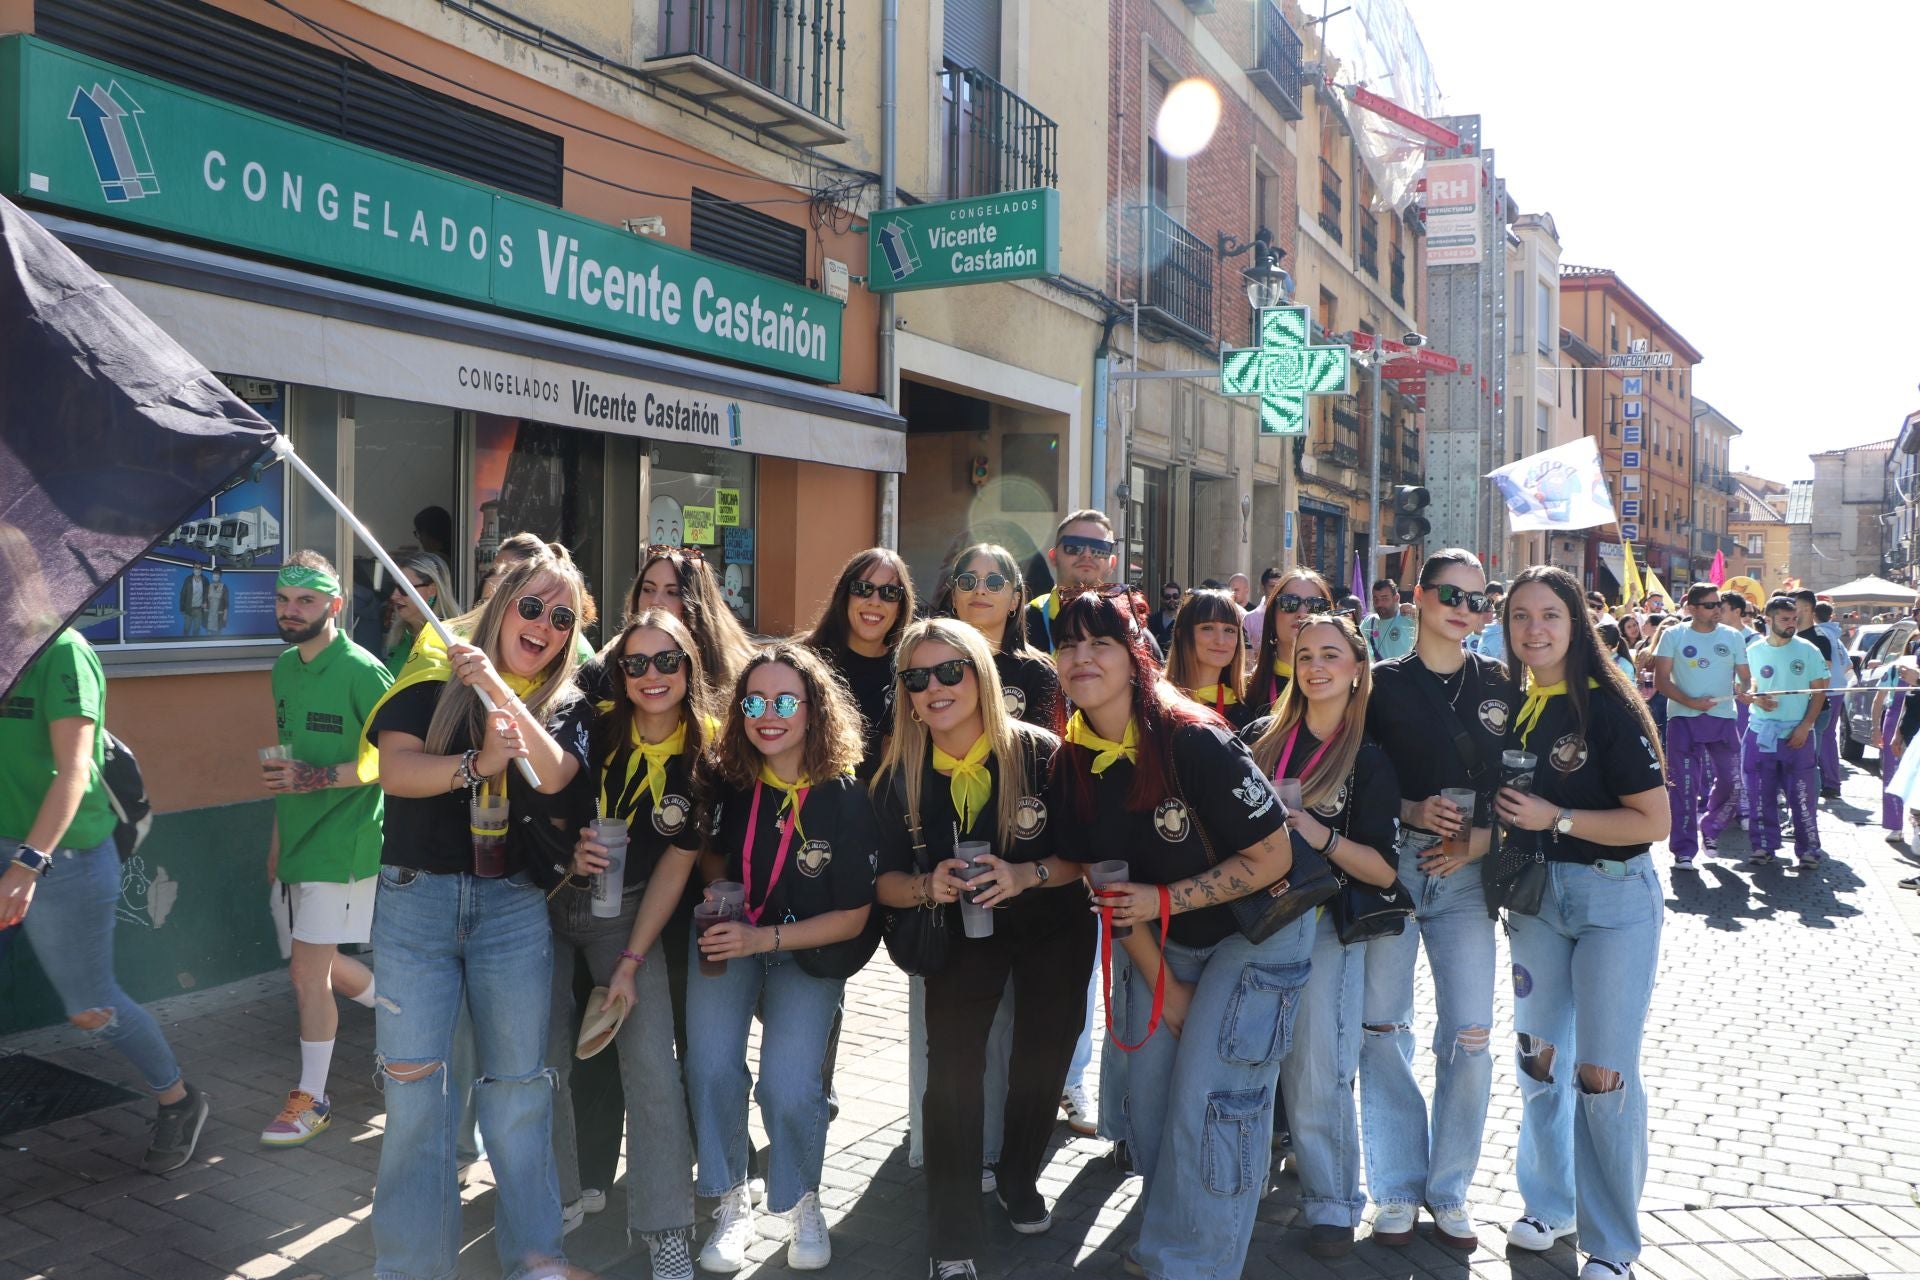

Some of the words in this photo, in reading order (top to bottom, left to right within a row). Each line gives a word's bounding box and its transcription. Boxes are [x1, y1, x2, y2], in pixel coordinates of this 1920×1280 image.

[1431, 180, 1468, 201] RH
[950, 200, 1037, 220] CONGELADOS
[1427, 206, 1473, 214] ESTRUCTURAS
[928, 222, 997, 249] Vicente
[204, 150, 513, 268] CONGELADOS
[537, 228, 681, 325] Vicente
[692, 276, 826, 362] Castañón
[951, 244, 1037, 274] Castañón
[1633, 341, 1647, 353] LA
[1609, 353, 1672, 367] CONFORMIDAD
[458, 366, 559, 403] CONGELADOS
[572, 379, 637, 424] Vicente
[644, 392, 719, 436] Castañón
[1621, 379, 1641, 539] MUEBLES
